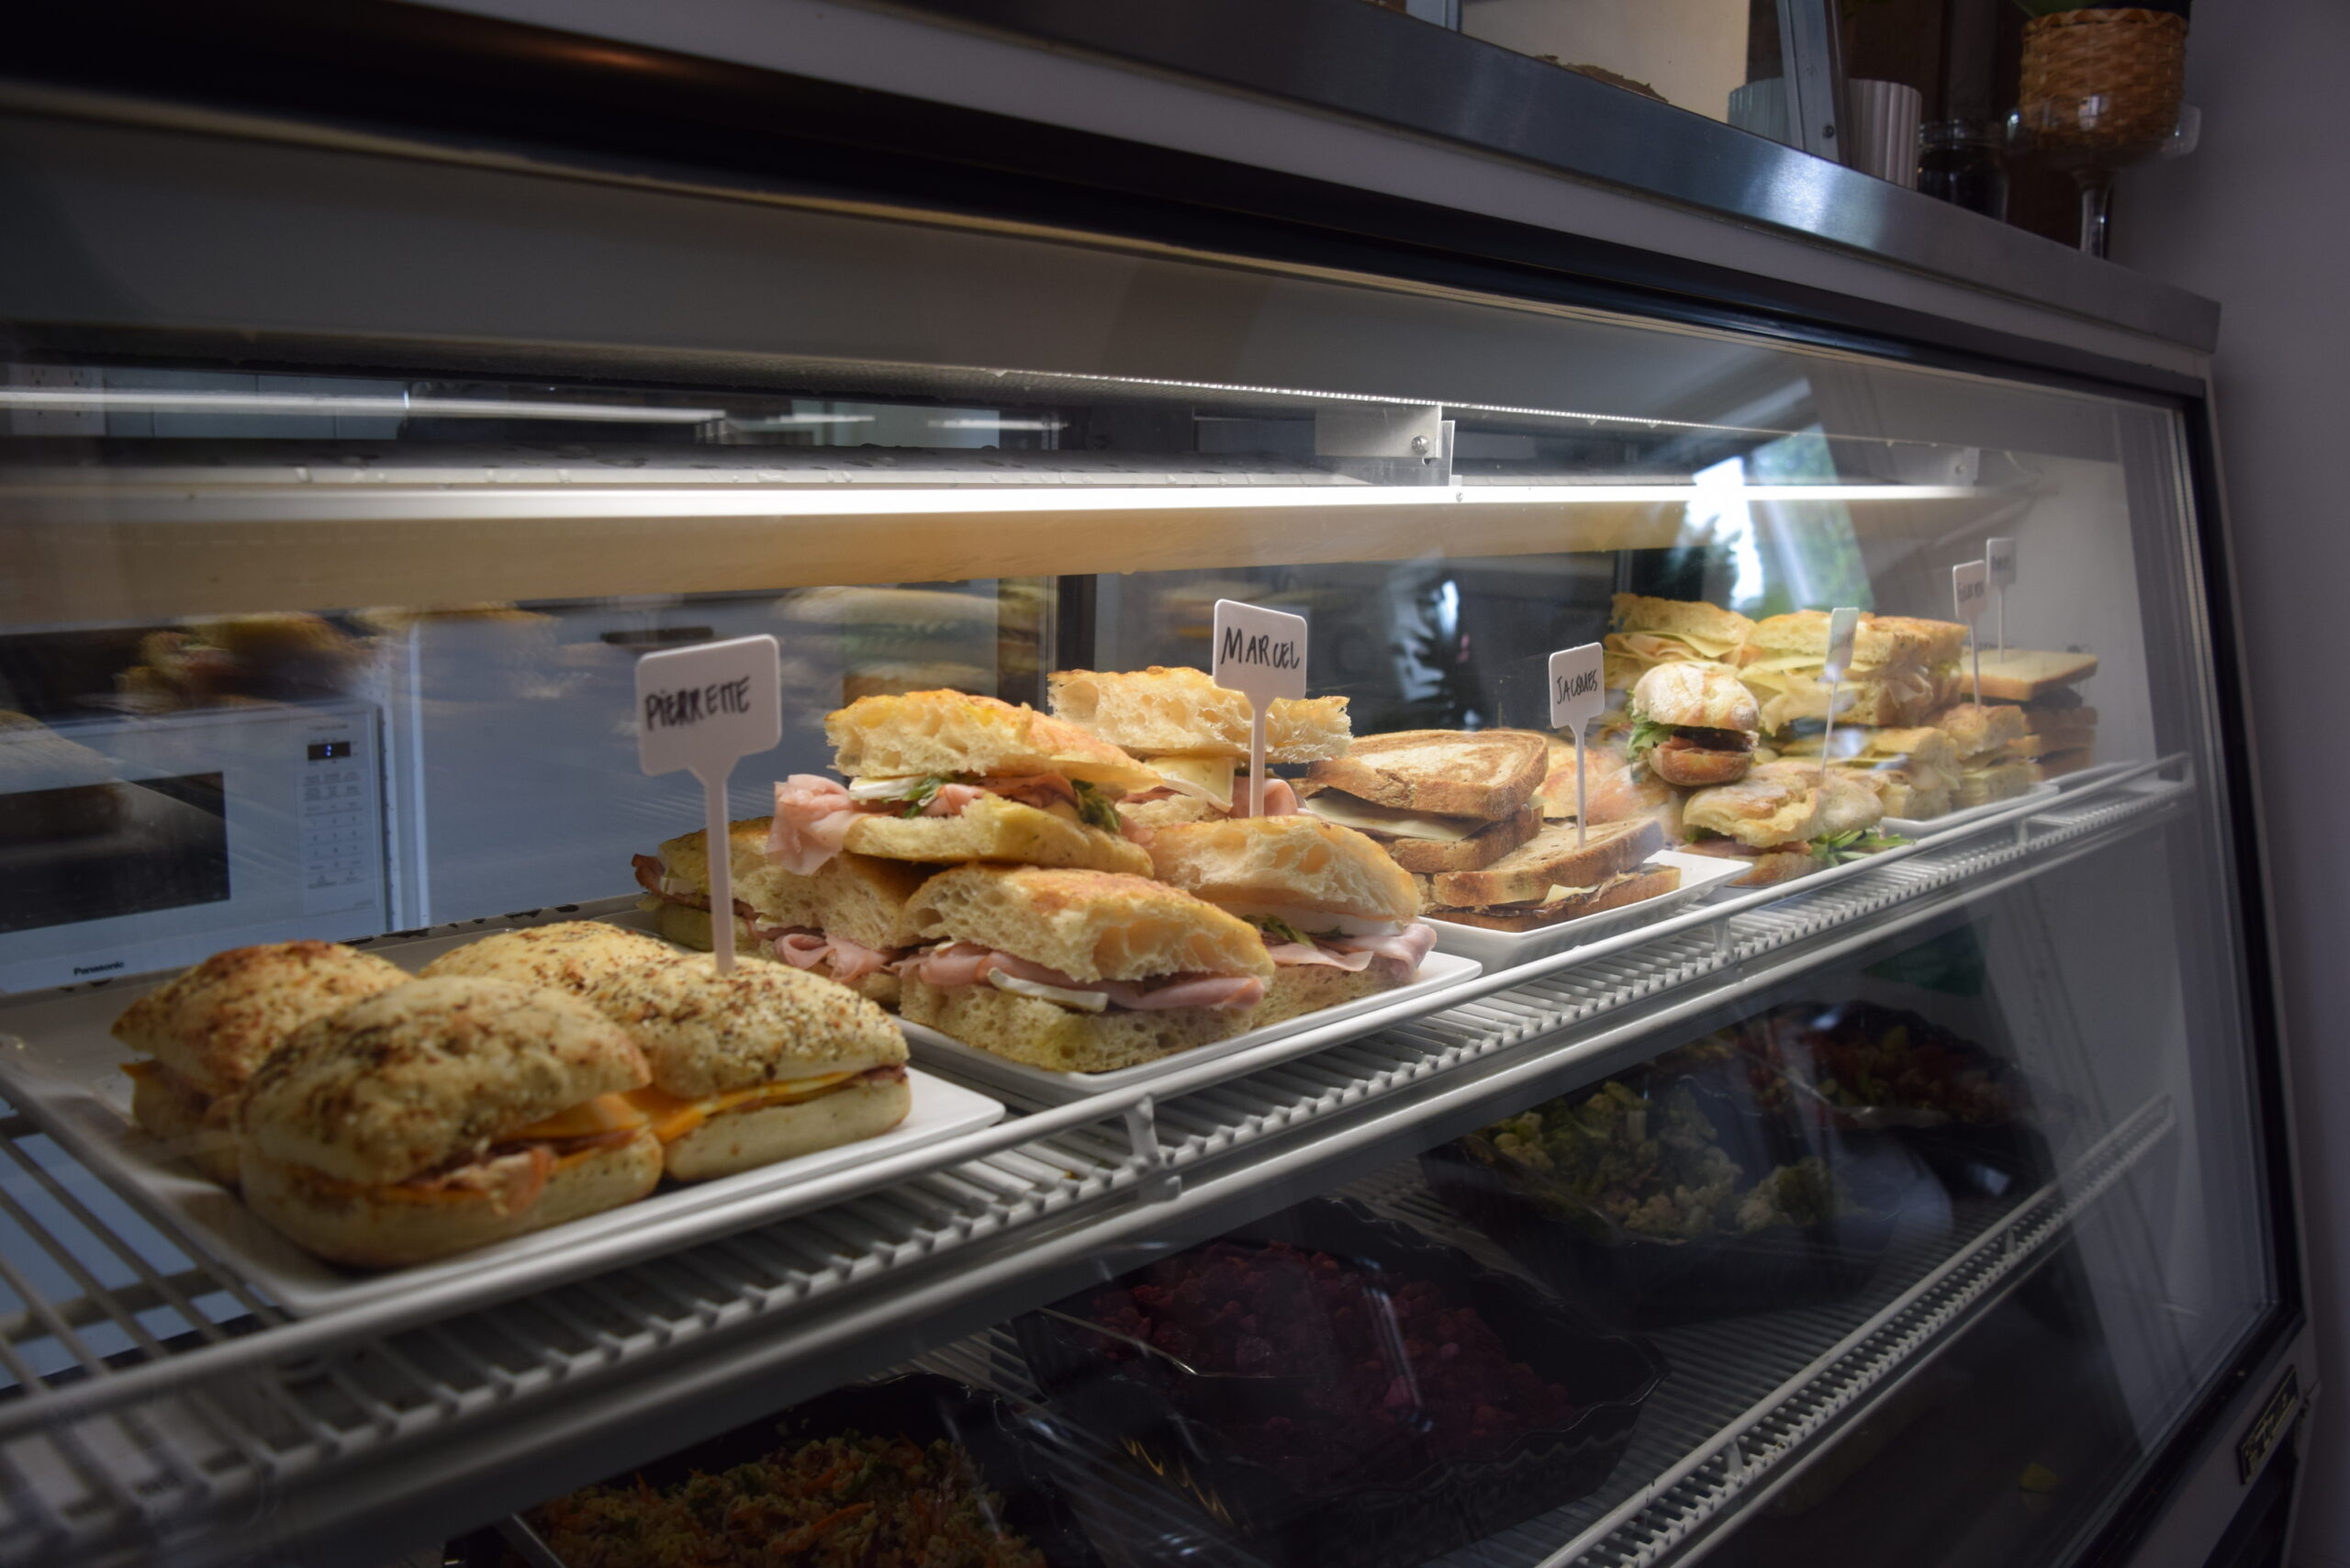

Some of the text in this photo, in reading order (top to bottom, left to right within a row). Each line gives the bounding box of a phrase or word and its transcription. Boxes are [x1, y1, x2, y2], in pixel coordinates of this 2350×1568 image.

[1220, 626, 1300, 669] MARCEL
[1557, 668, 1597, 704] JACQUES
[73, 961, 125, 977] Panasonic
